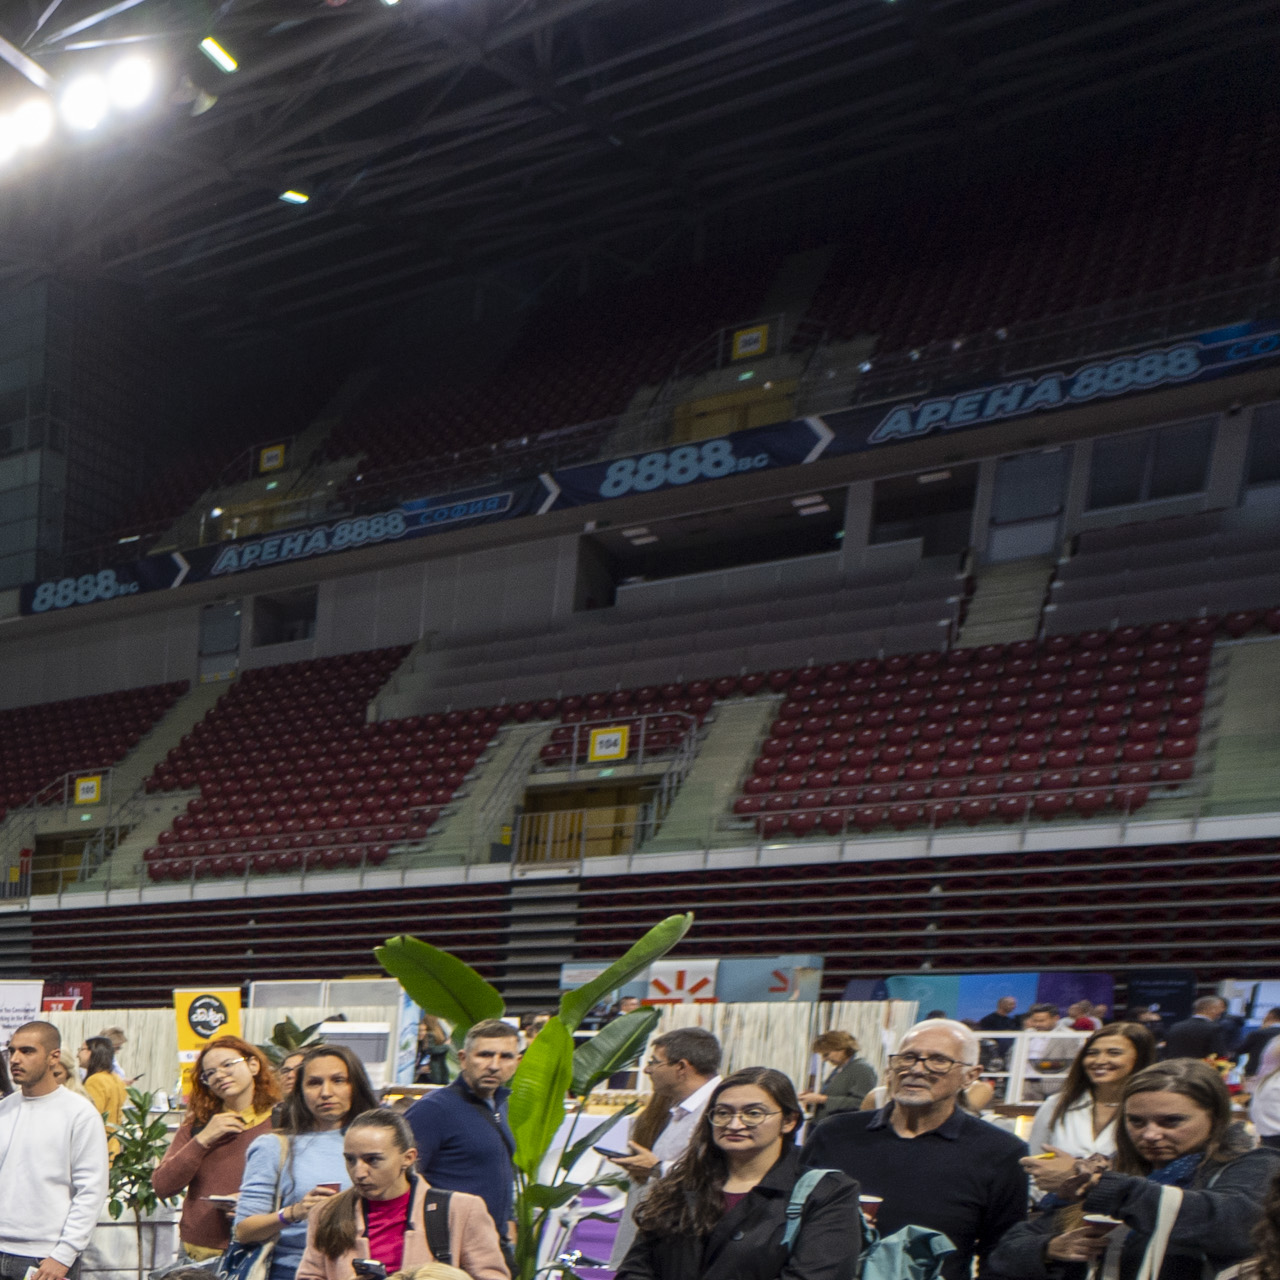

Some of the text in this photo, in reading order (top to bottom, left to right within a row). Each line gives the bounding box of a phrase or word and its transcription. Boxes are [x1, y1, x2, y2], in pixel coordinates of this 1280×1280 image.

[872, 378, 1061, 441] АРЕНА
[1069, 346, 1200, 400] 8888
[219, 526, 329, 572] АРЕНА
[331, 513, 406, 551] 8888
